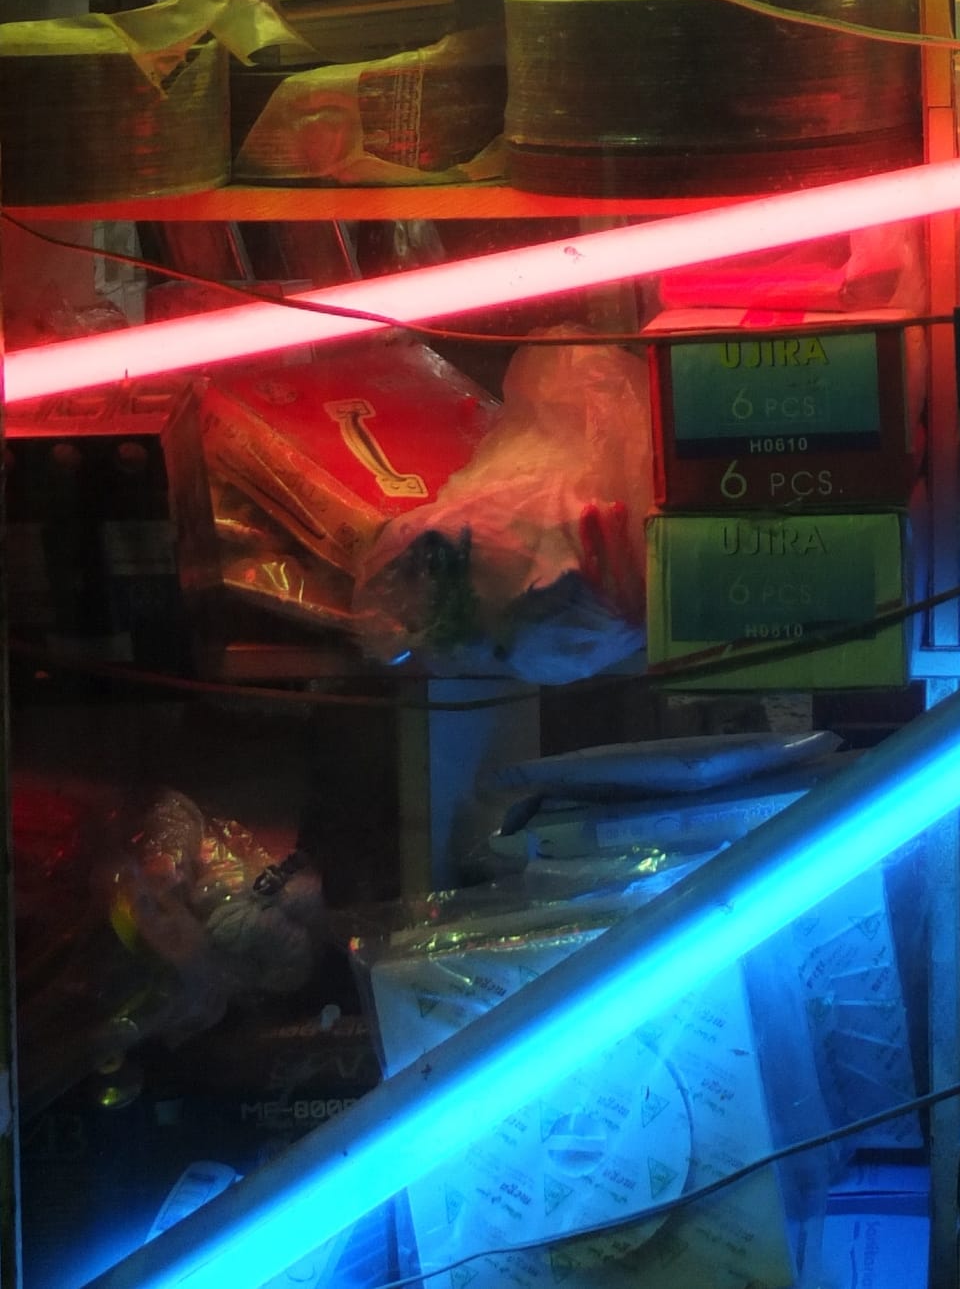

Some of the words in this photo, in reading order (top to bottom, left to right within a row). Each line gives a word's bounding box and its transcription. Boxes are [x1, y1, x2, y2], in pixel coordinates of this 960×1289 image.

[720, 336, 829, 369] UJIRA
[731, 388, 754, 419] 6
[749, 437, 808, 454] H0610
[720, 460, 748, 499] 6
[729, 575, 750, 606] 6
